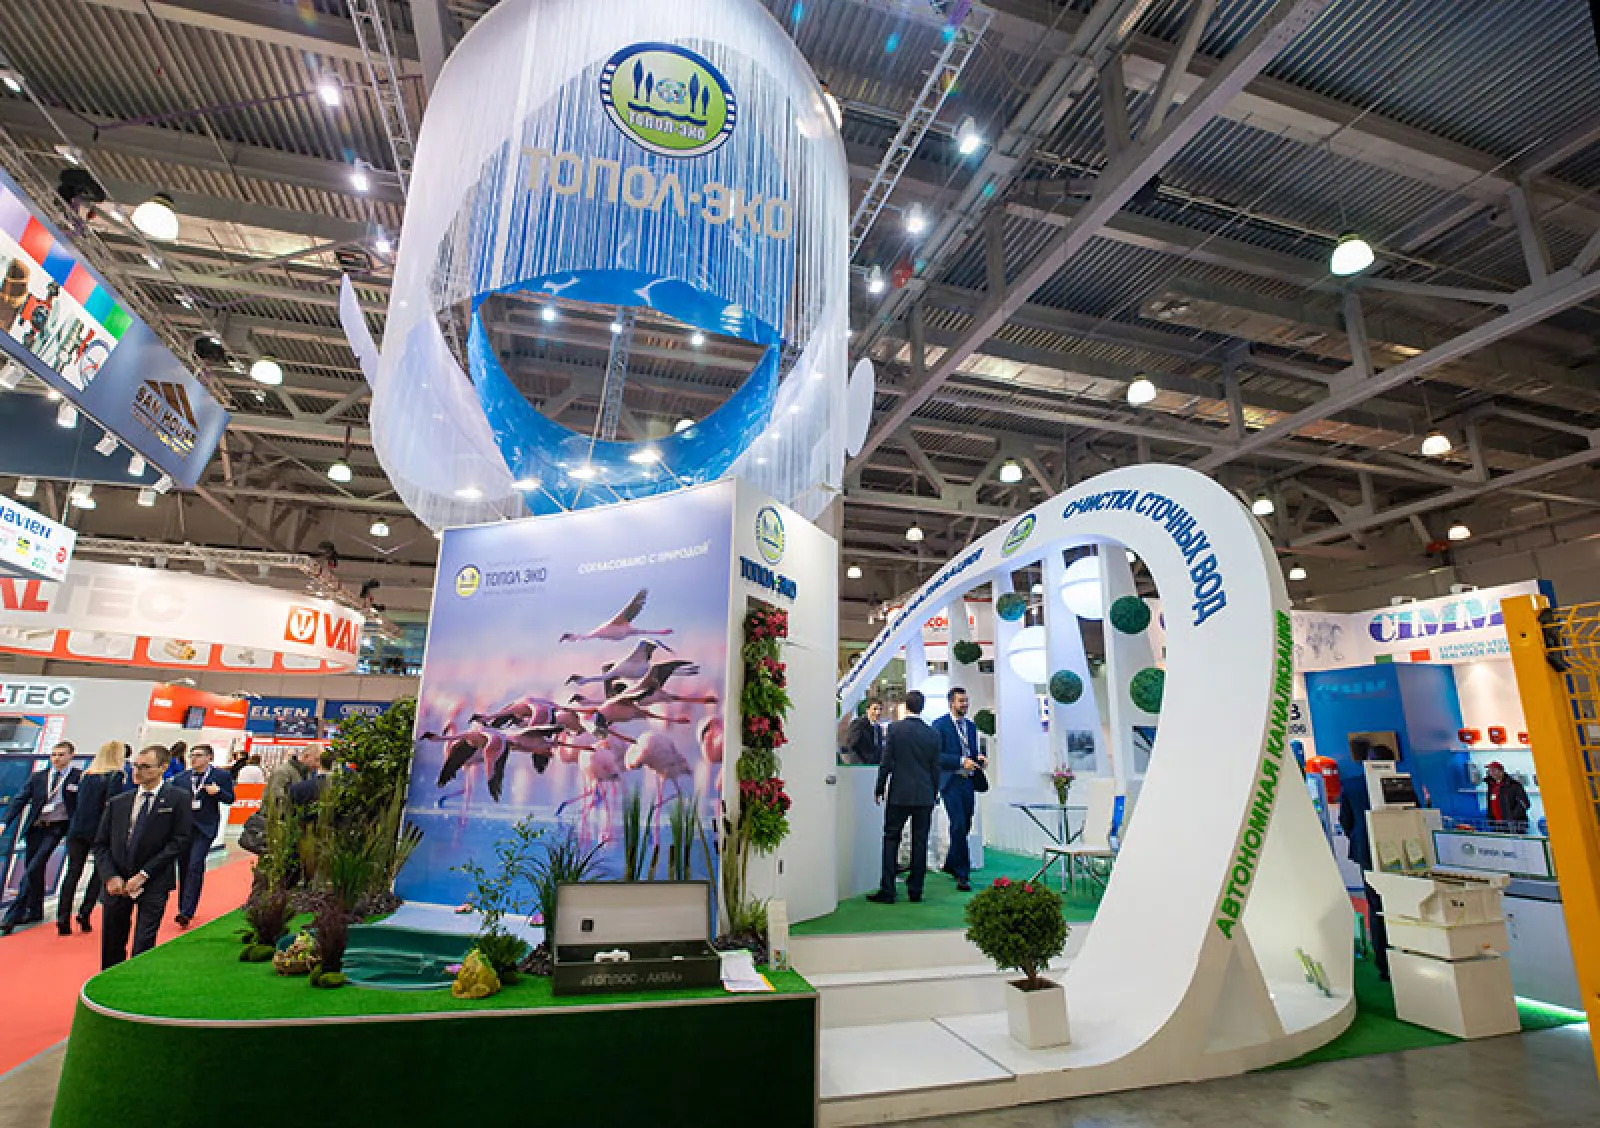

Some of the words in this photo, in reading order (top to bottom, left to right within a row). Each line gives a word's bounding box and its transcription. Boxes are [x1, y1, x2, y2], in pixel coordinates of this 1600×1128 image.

[1062, 489, 1140, 519] ОЧИСТКА
[1135, 491, 1211, 567] СТОЧНЫХ
[1190, 553, 1228, 627] ВОД
[251, 705, 310, 718] ELSEN
[1215, 758, 1281, 939] АВТОНОМНАЯ
[1266, 609, 1295, 760] КАНАЛИЗАЦИЯ
